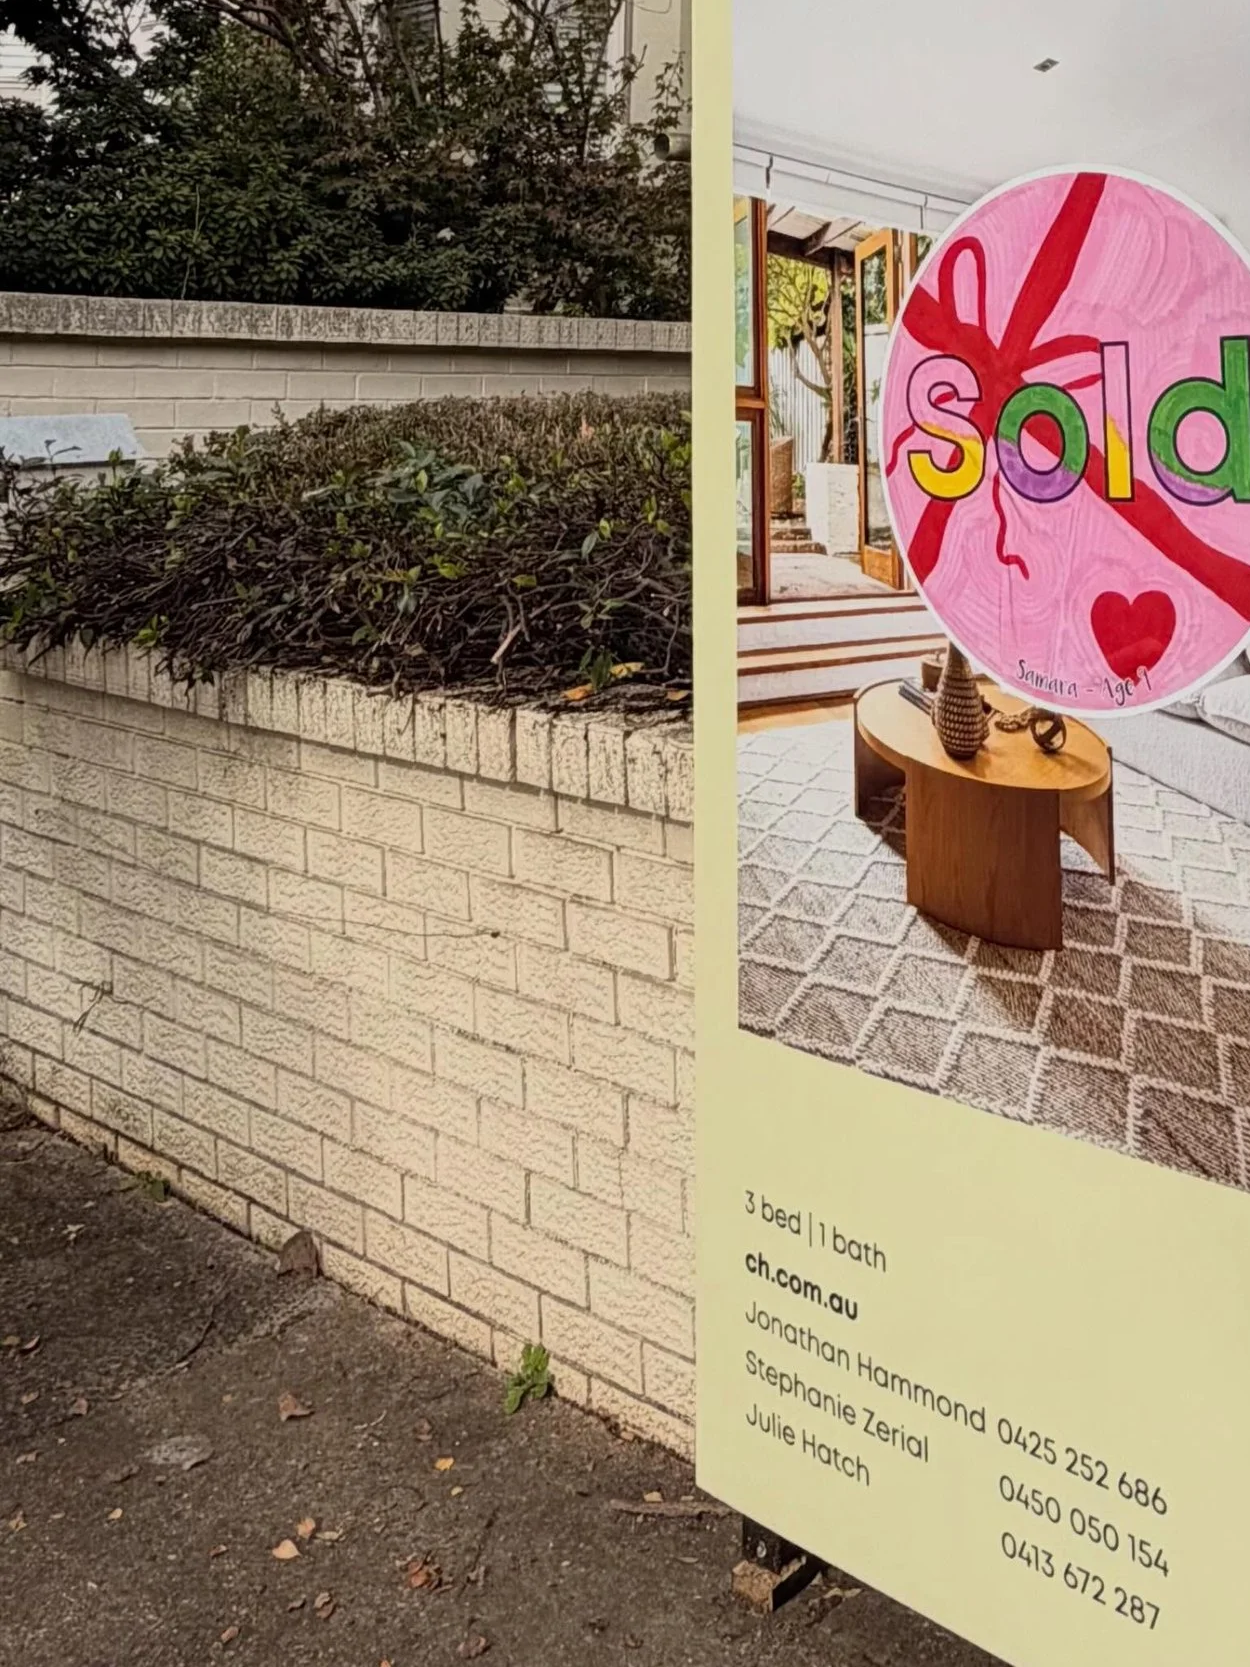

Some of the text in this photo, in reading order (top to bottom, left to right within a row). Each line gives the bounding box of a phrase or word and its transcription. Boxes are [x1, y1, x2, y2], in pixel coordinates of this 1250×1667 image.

[1017, 659, 1078, 698] Samara
[1102, 677, 1133, 707] Age
[745, 1189, 757, 1215] 3
[761, 1194, 802, 1236] bed
[818, 1221, 826, 1247] 1
[832, 1225, 887, 1273] bath
[745, 1251, 859, 1321] ch.com.au
[745, 1301, 1168, 1516] Jonathan Hammond 0425 252 686
[745, 1349, 1170, 1578] Stephanie Zerial 0450 050 154
[745, 1403, 1162, 1631] Julie Hatch 0413 672 287
